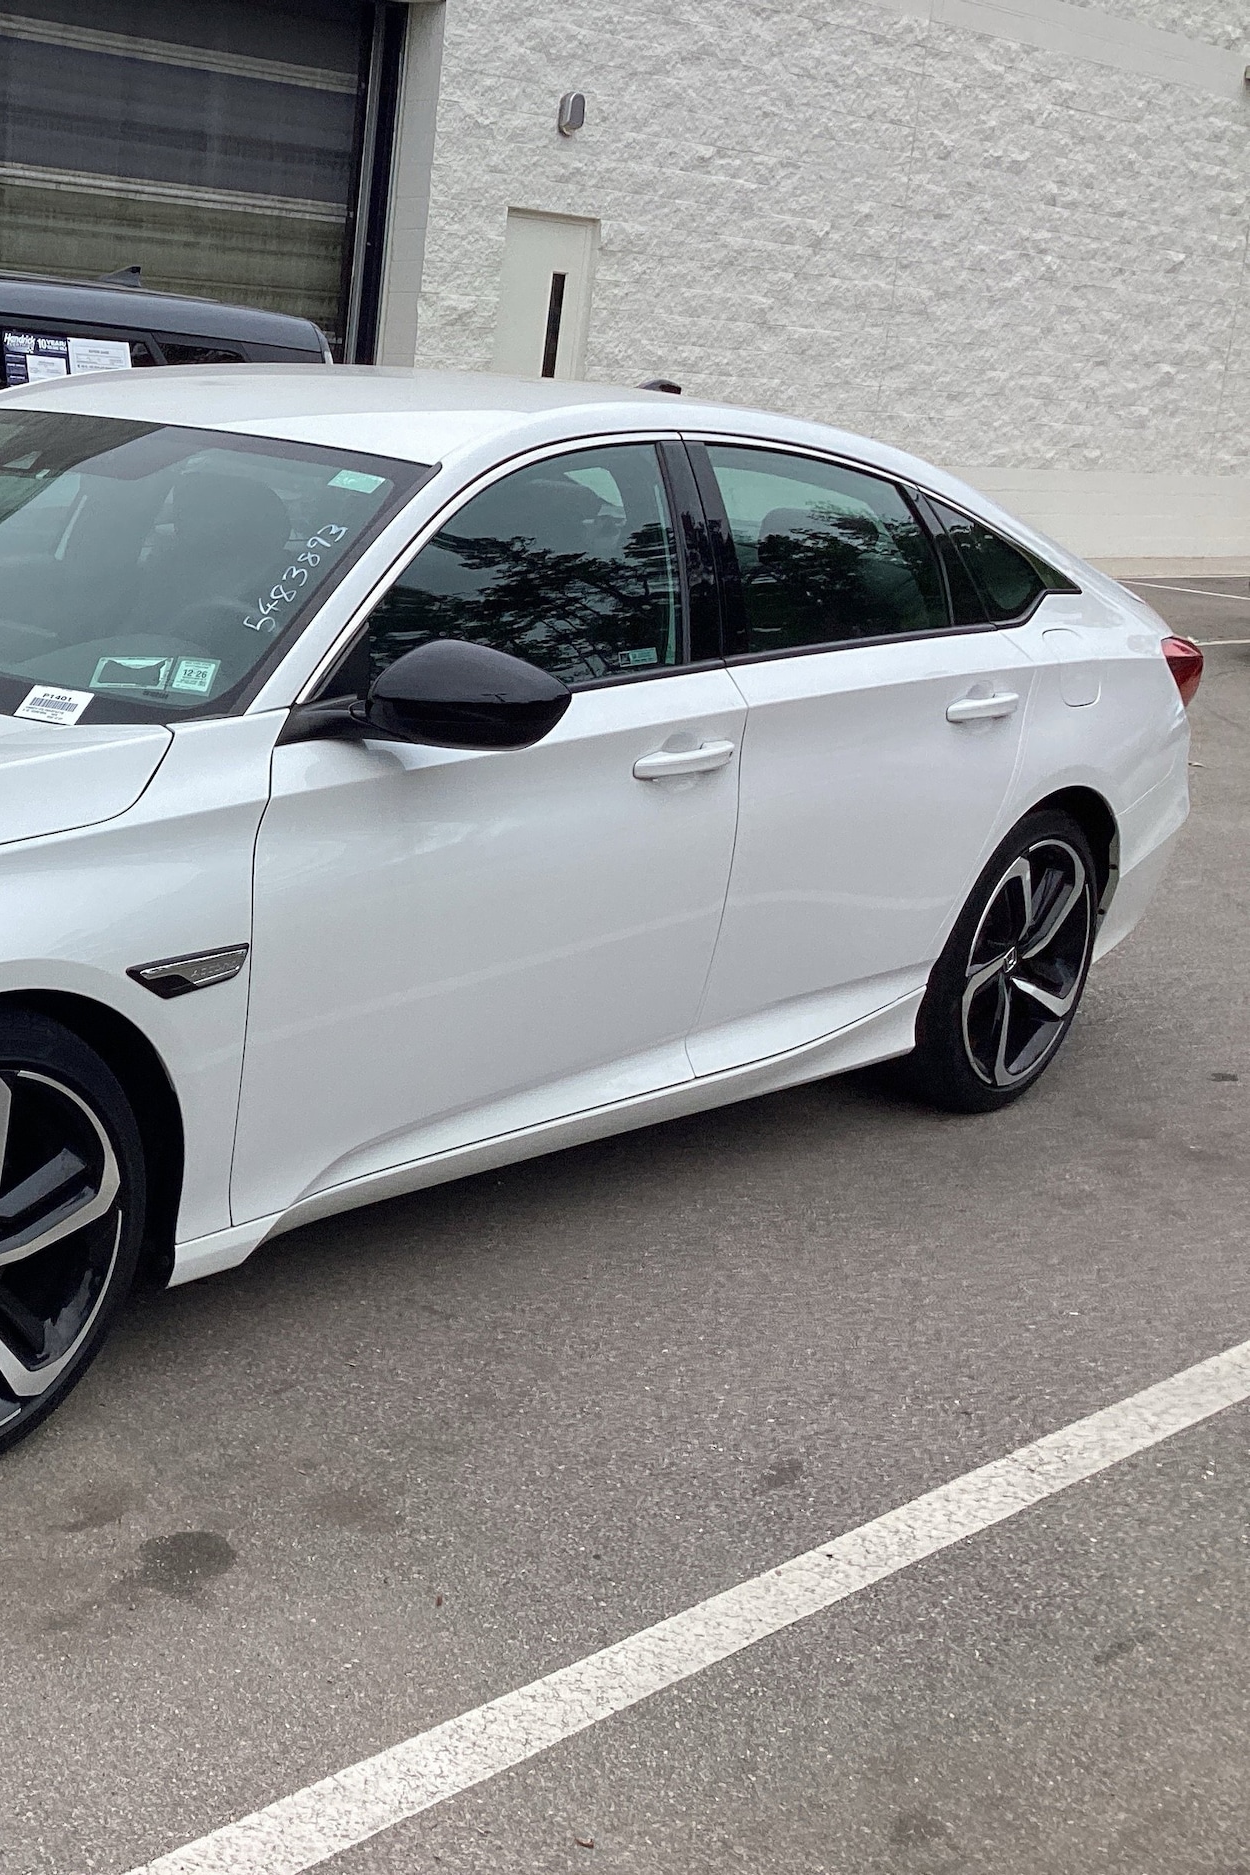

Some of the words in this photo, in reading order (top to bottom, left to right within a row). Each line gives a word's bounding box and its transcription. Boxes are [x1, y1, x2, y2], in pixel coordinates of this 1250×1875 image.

[37, 338, 46, 349] 10
[243, 523, 349, 633] 5483893
[42, 692, 73, 702] P1401
